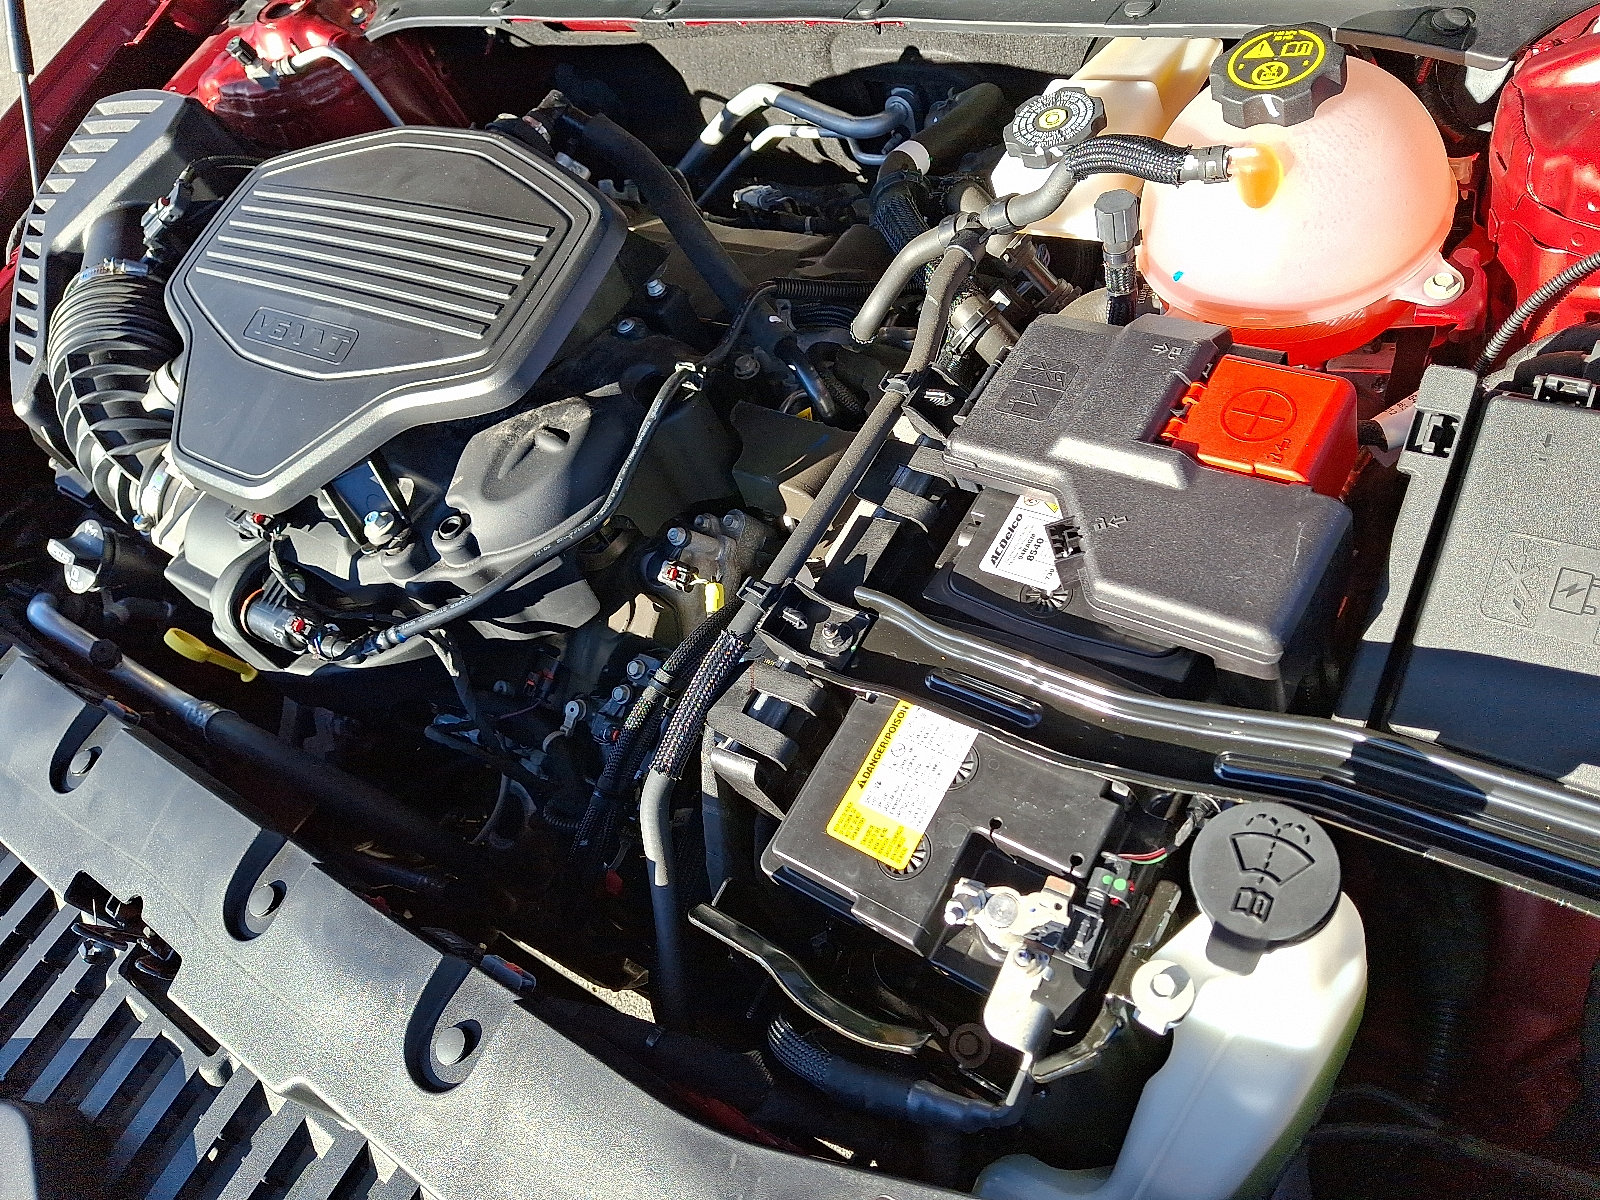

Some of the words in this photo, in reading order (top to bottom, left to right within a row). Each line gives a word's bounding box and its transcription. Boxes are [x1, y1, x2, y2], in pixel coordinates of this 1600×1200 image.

[990, 513, 1023, 565] ACDelco
[1027, 537, 1044, 562] 8540
[862, 705, 909, 779] DANGER/POISON
